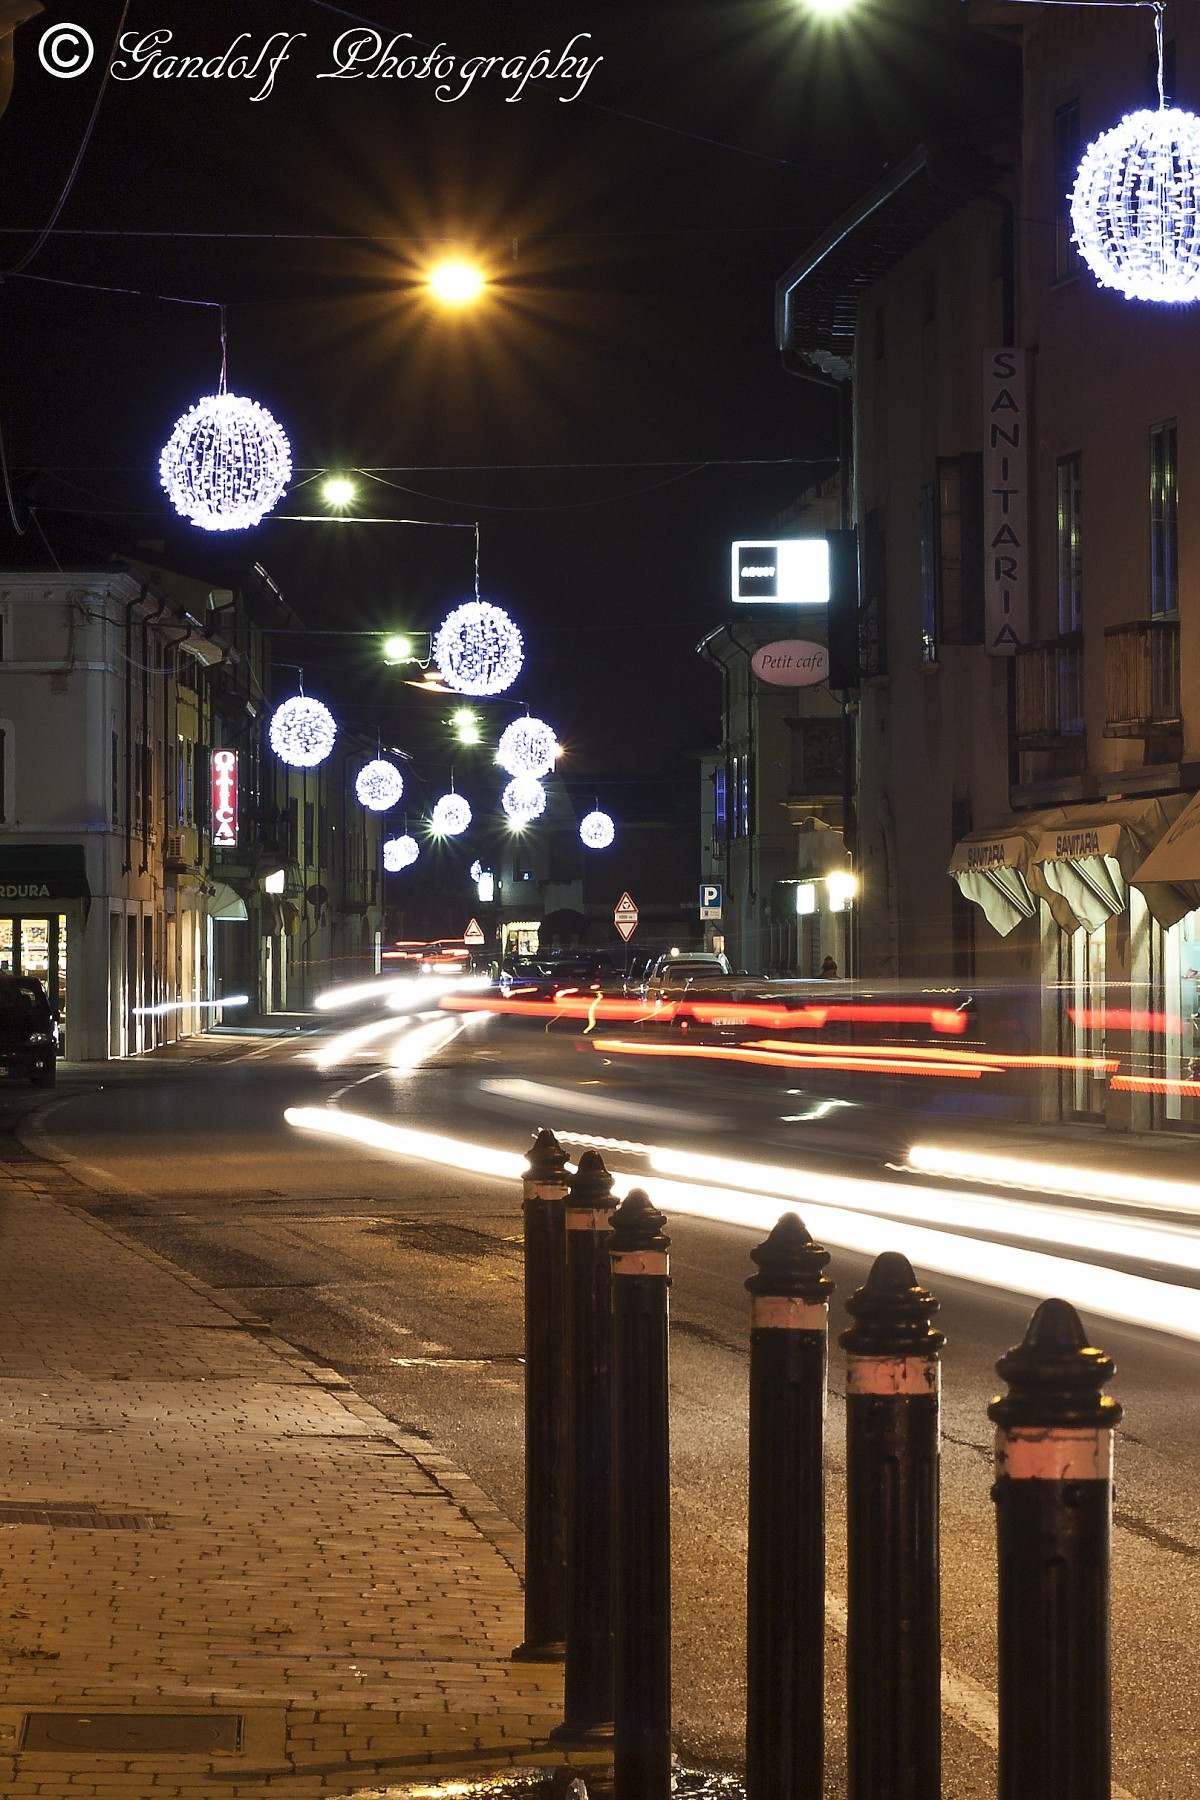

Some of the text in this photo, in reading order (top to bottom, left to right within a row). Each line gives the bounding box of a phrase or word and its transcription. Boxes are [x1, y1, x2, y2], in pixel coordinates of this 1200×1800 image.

[990, 352, 1021, 649] SANITARIA
[761, 652, 823, 672] Petit cafe
[214, 751, 236, 837] OTTICA
[704, 887, 718, 906] P
